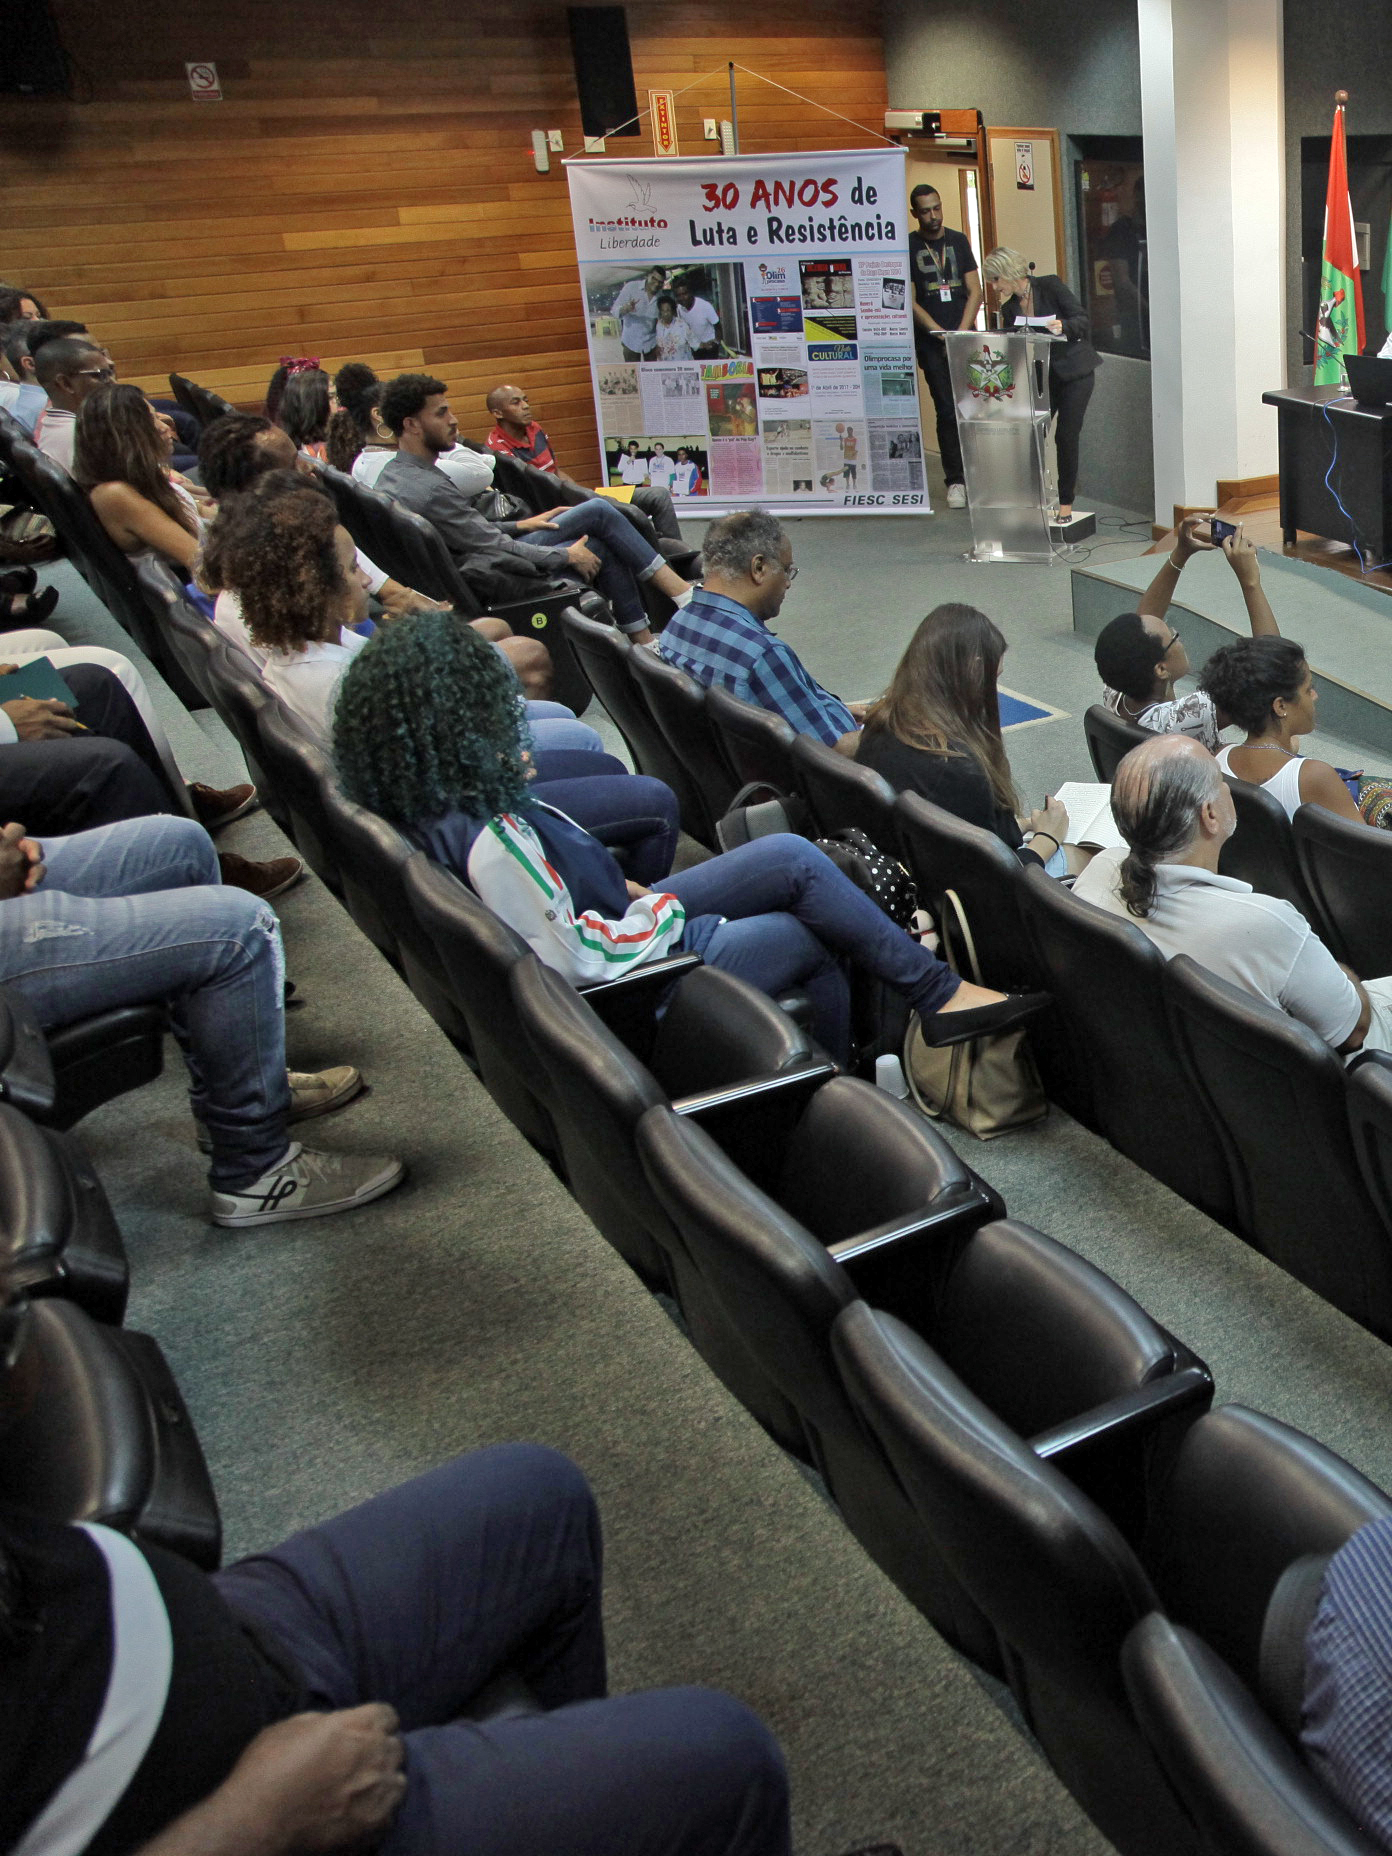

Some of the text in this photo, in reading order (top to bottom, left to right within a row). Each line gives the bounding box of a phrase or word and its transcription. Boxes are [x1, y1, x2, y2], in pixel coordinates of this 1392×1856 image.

[659, 98, 669, 146] EXTINTOR
[701, 176, 878, 213] 30 ANOS de
[588, 215, 668, 233] Instituto
[689, 214, 896, 247] Luta e Resistência
[600, 235, 660, 250] Liberdade
[811, 351, 854, 360] CULTURAL
[864, 355, 901, 363] Olimprocasa
[843, 494, 924, 505] FIESC SESI
